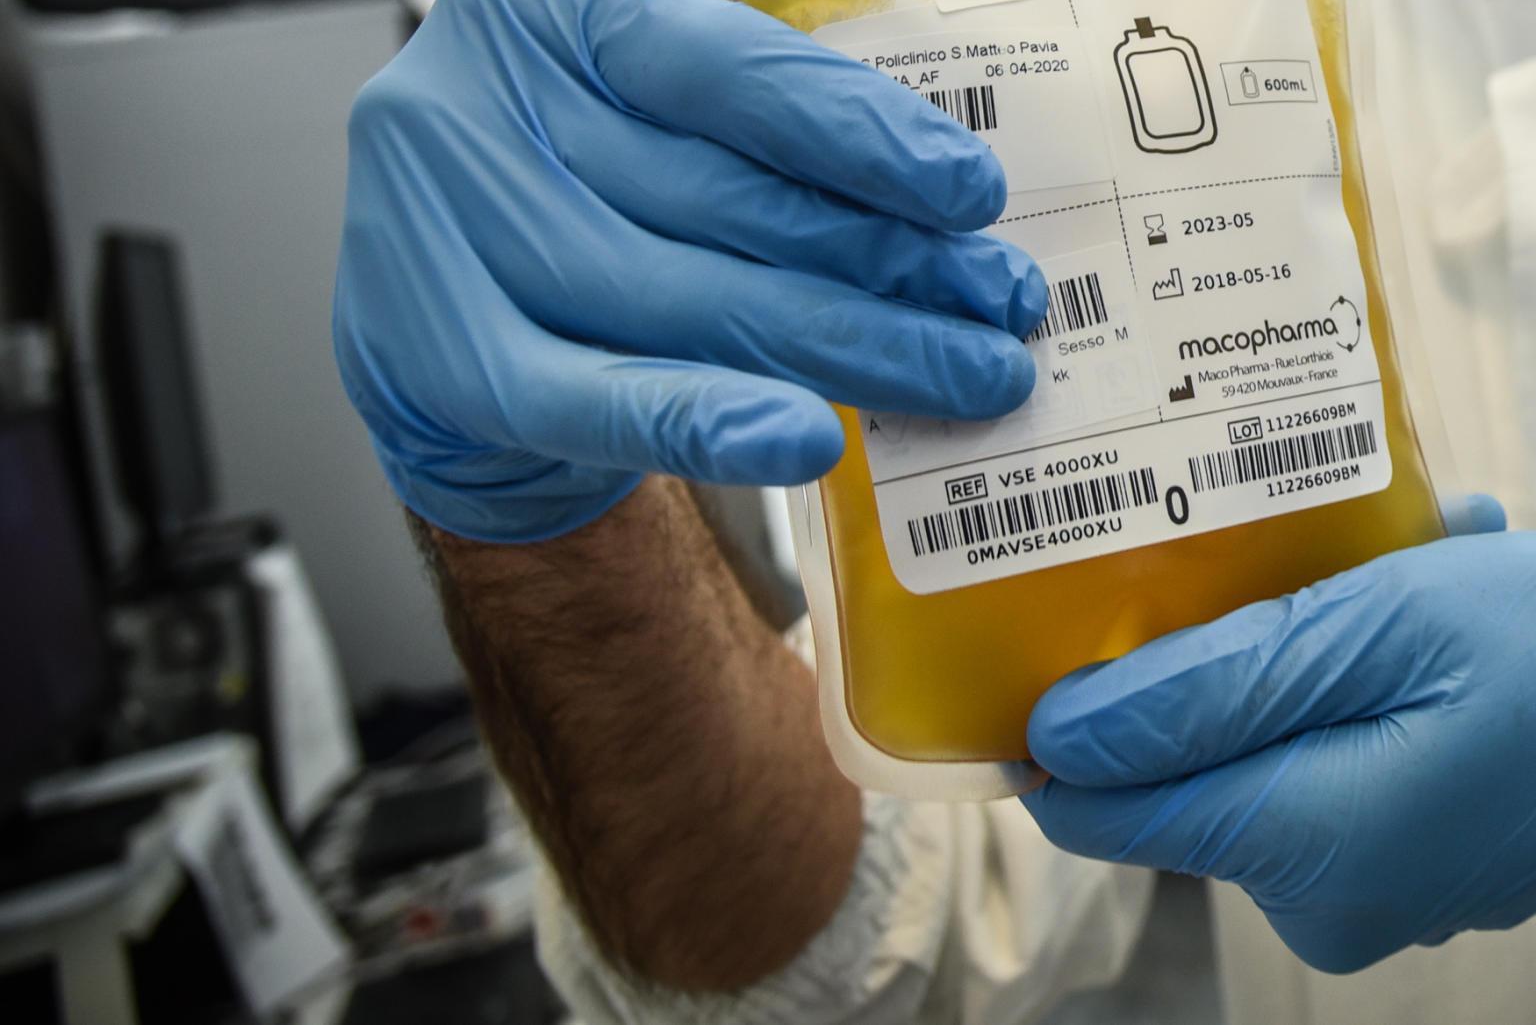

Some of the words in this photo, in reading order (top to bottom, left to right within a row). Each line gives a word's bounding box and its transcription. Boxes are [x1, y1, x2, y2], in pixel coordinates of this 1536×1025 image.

[875, 50, 947, 70] Policlinico
[1019, 40, 1059, 53] Pavia
[1264, 78, 1307, 91] 600mL
[1182, 212, 1254, 235] 2023-05
[1192, 264, 1292, 292] 2018-05-16
[1058, 335, 1105, 356] Sesso
[1115, 326, 1128, 341] M
[1178, 317, 1339, 360] macopharma
[1198, 370, 1230, 383] Maco
[1229, 361, 1271, 378] Pharma
[1275, 357, 1295, 370] Rue
[1257, 374, 1304, 391] Mouvaux
[1308, 368, 1339, 382] France
[1232, 422, 1261, 441] LOT
[951, 478, 984, 500] REF
[998, 467, 1036, 488] VSE
[1044, 449, 1119, 477] 4000XU
